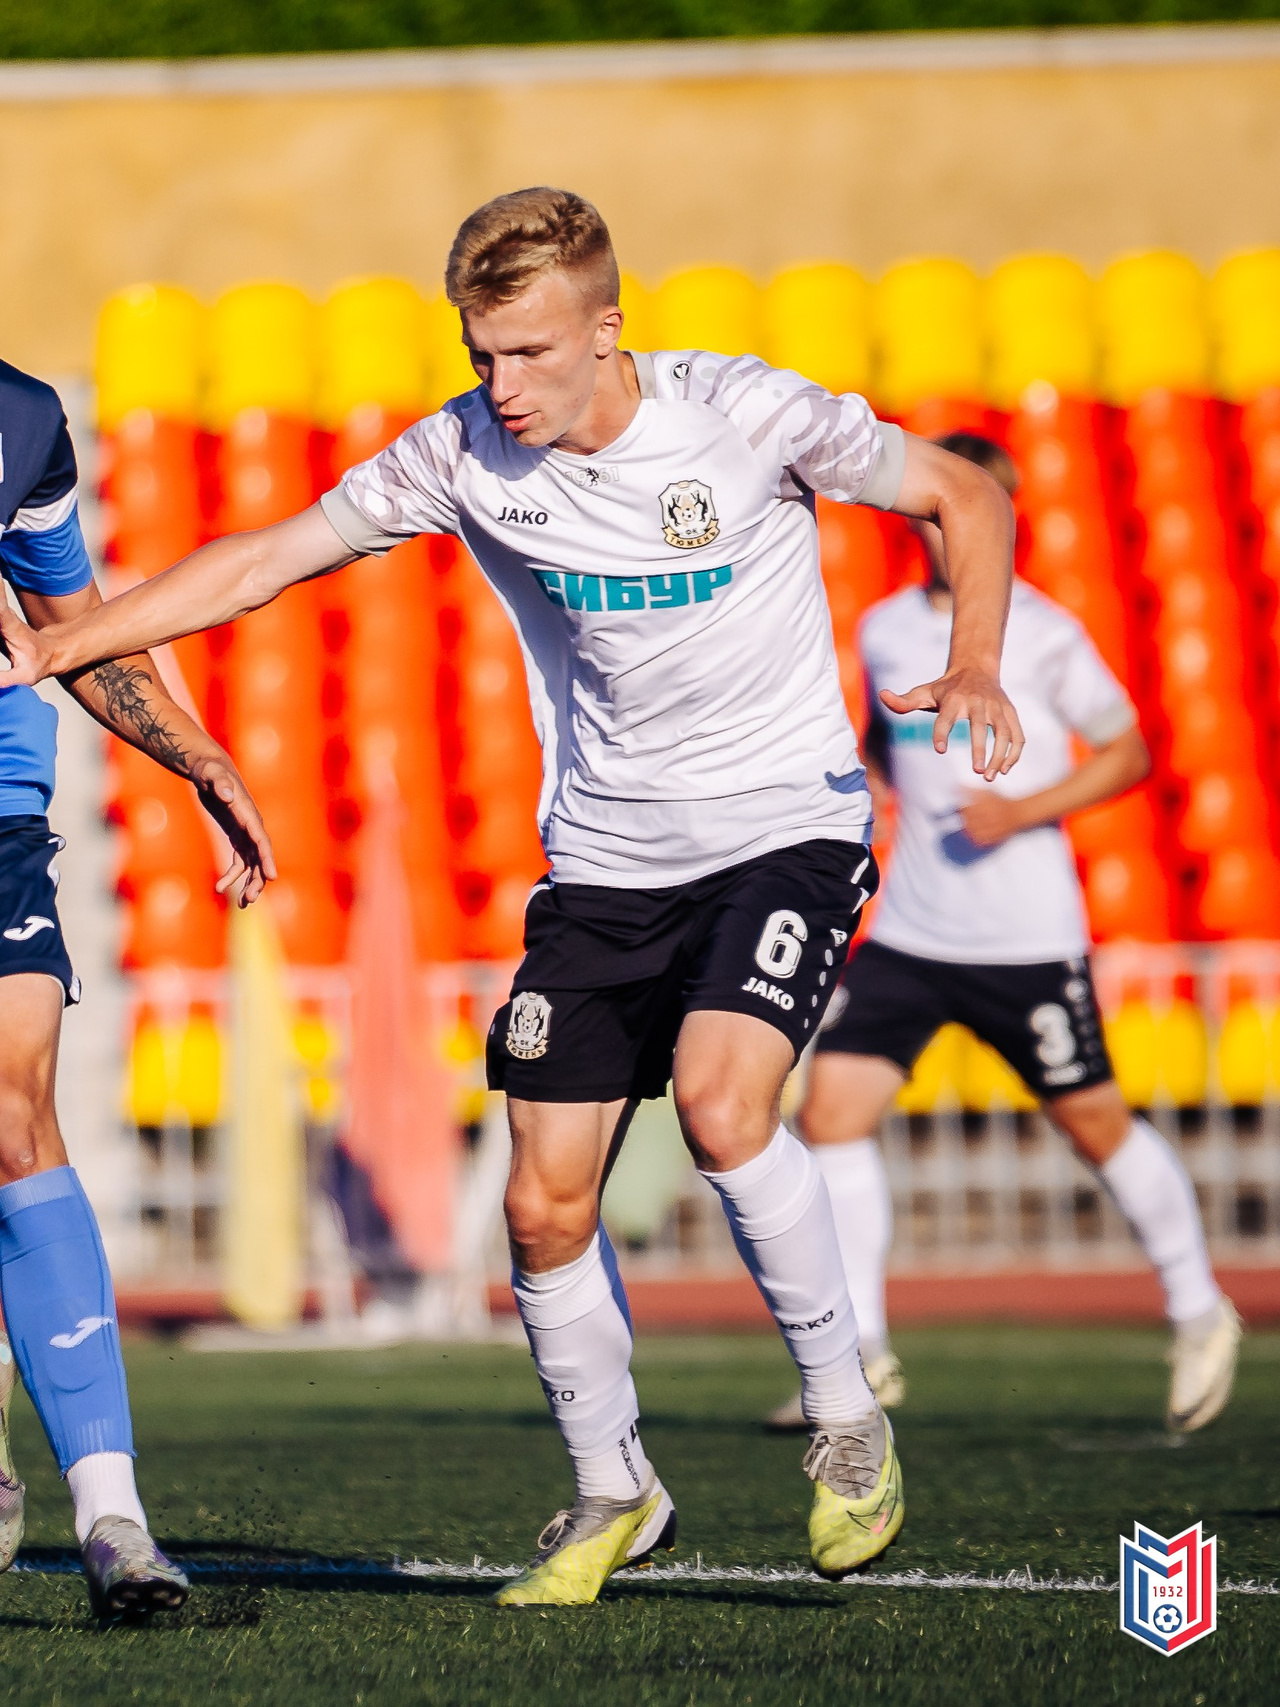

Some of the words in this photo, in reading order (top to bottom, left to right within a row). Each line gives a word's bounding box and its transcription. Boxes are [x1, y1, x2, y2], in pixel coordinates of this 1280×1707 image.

[497, 506, 549, 526] JAKO
[531, 564, 733, 613] СИБУР
[754, 909, 809, 979] 6
[741, 976, 795, 1012] JAKO
[1028, 1003, 1077, 1068] 3
